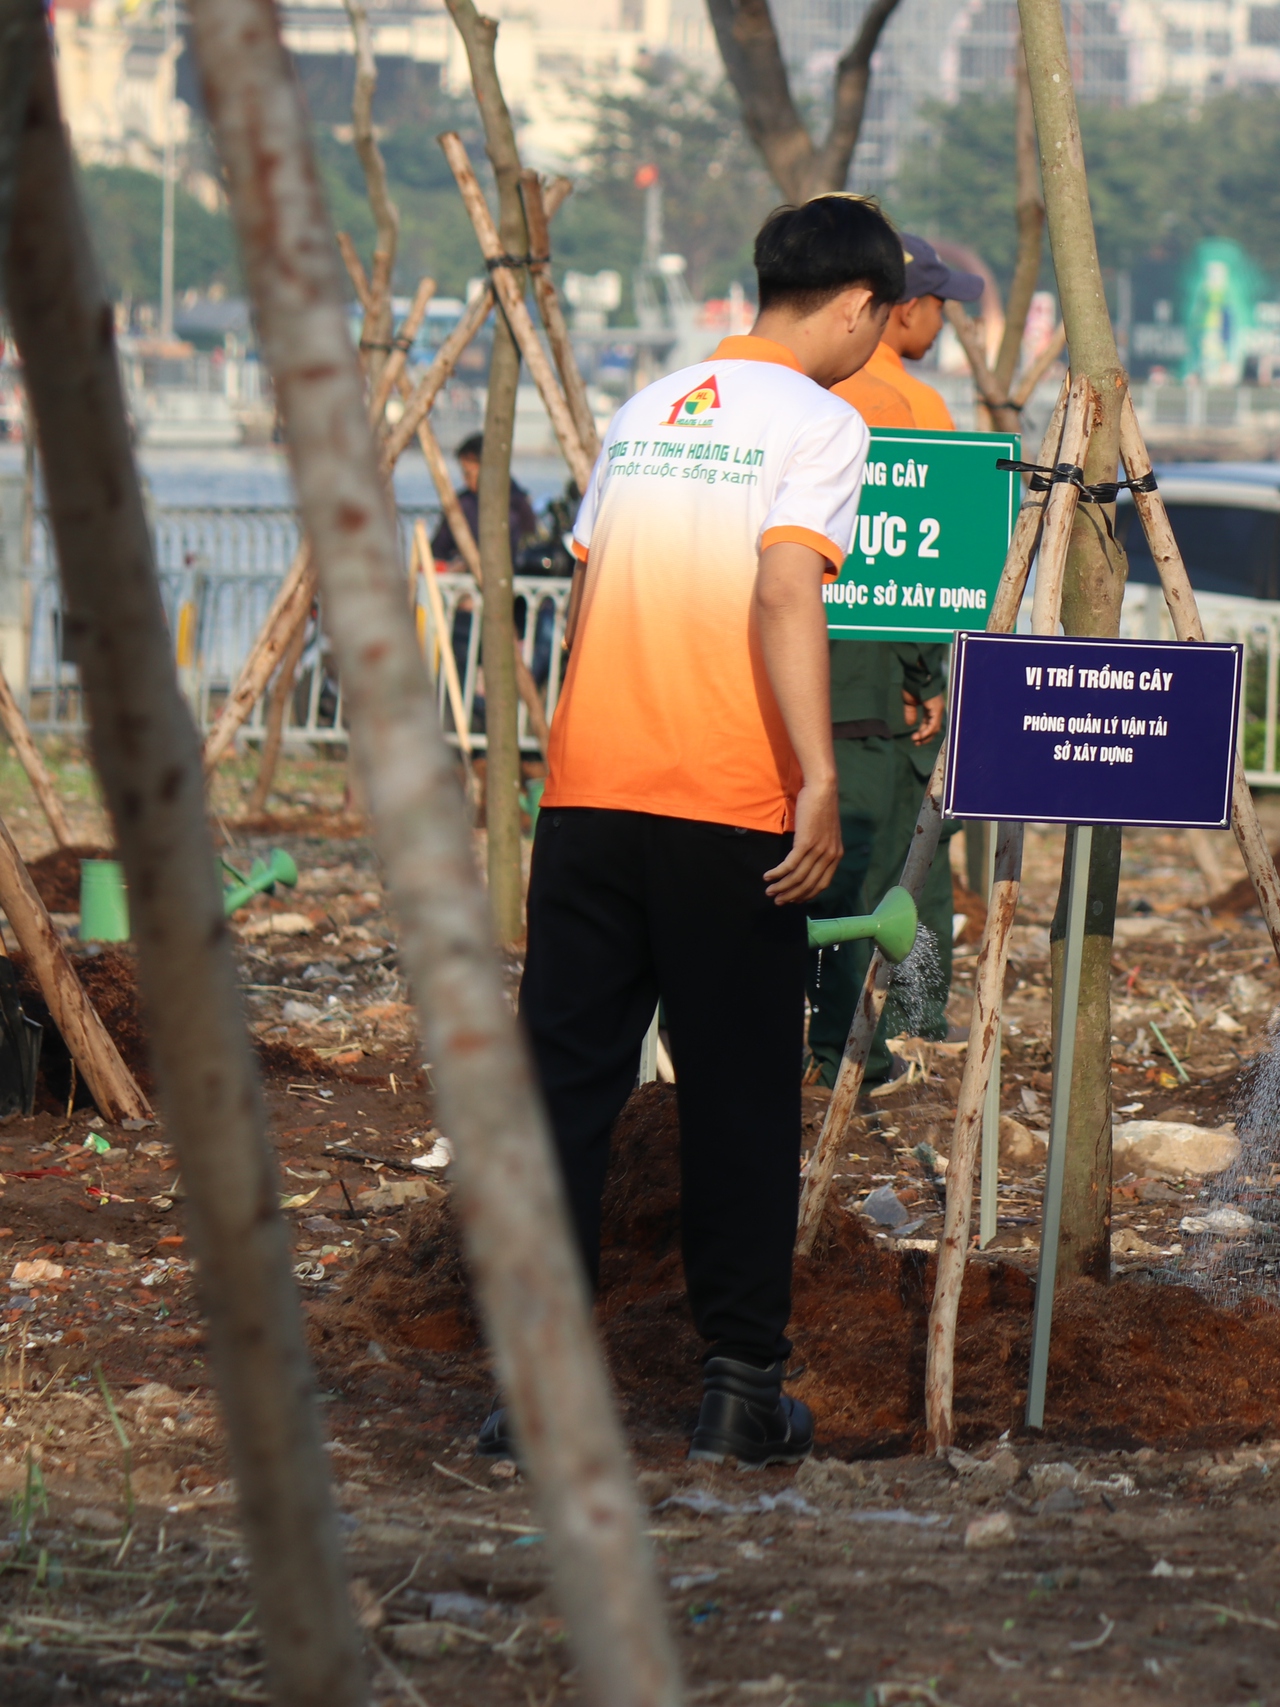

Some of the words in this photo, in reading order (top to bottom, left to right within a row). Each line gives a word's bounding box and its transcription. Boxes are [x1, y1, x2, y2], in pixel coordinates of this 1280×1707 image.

[633, 441, 648, 457] TY
[652, 441, 685, 458] TNHH
[733, 446, 765, 467] LAM
[613, 461, 641, 477] một
[643, 462, 679, 477] cuộc
[681, 463, 718, 484] sống
[720, 470, 758, 486] xanh
[862, 461, 887, 486] NG
[892, 459, 929, 488] CÂY
[917, 517, 941, 558] 2
[821, 580, 868, 609] HUỘC
[873, 579, 898, 606] SỞ
[901, 583, 935, 608] XÂY
[939, 586, 987, 612] DỰNG
[1025, 666, 1042, 690] VỊ
[1046, 664, 1075, 688] TRÍ
[1078, 663, 1135, 690] TRỒNG
[1138, 668, 1173, 691] CÂY
[1023, 712, 1065, 732] PHÒNG
[1067, 712, 1101, 734] QUẢN
[1103, 716, 1119, 734] LÝ
[1121, 717, 1146, 738] VẬN
[1149, 715, 1168, 736] TẢI
[1053, 740, 1072, 760] SỞ
[1072, 742, 1098, 761] XÂY
[1099, 745, 1134, 765] DỰNG
